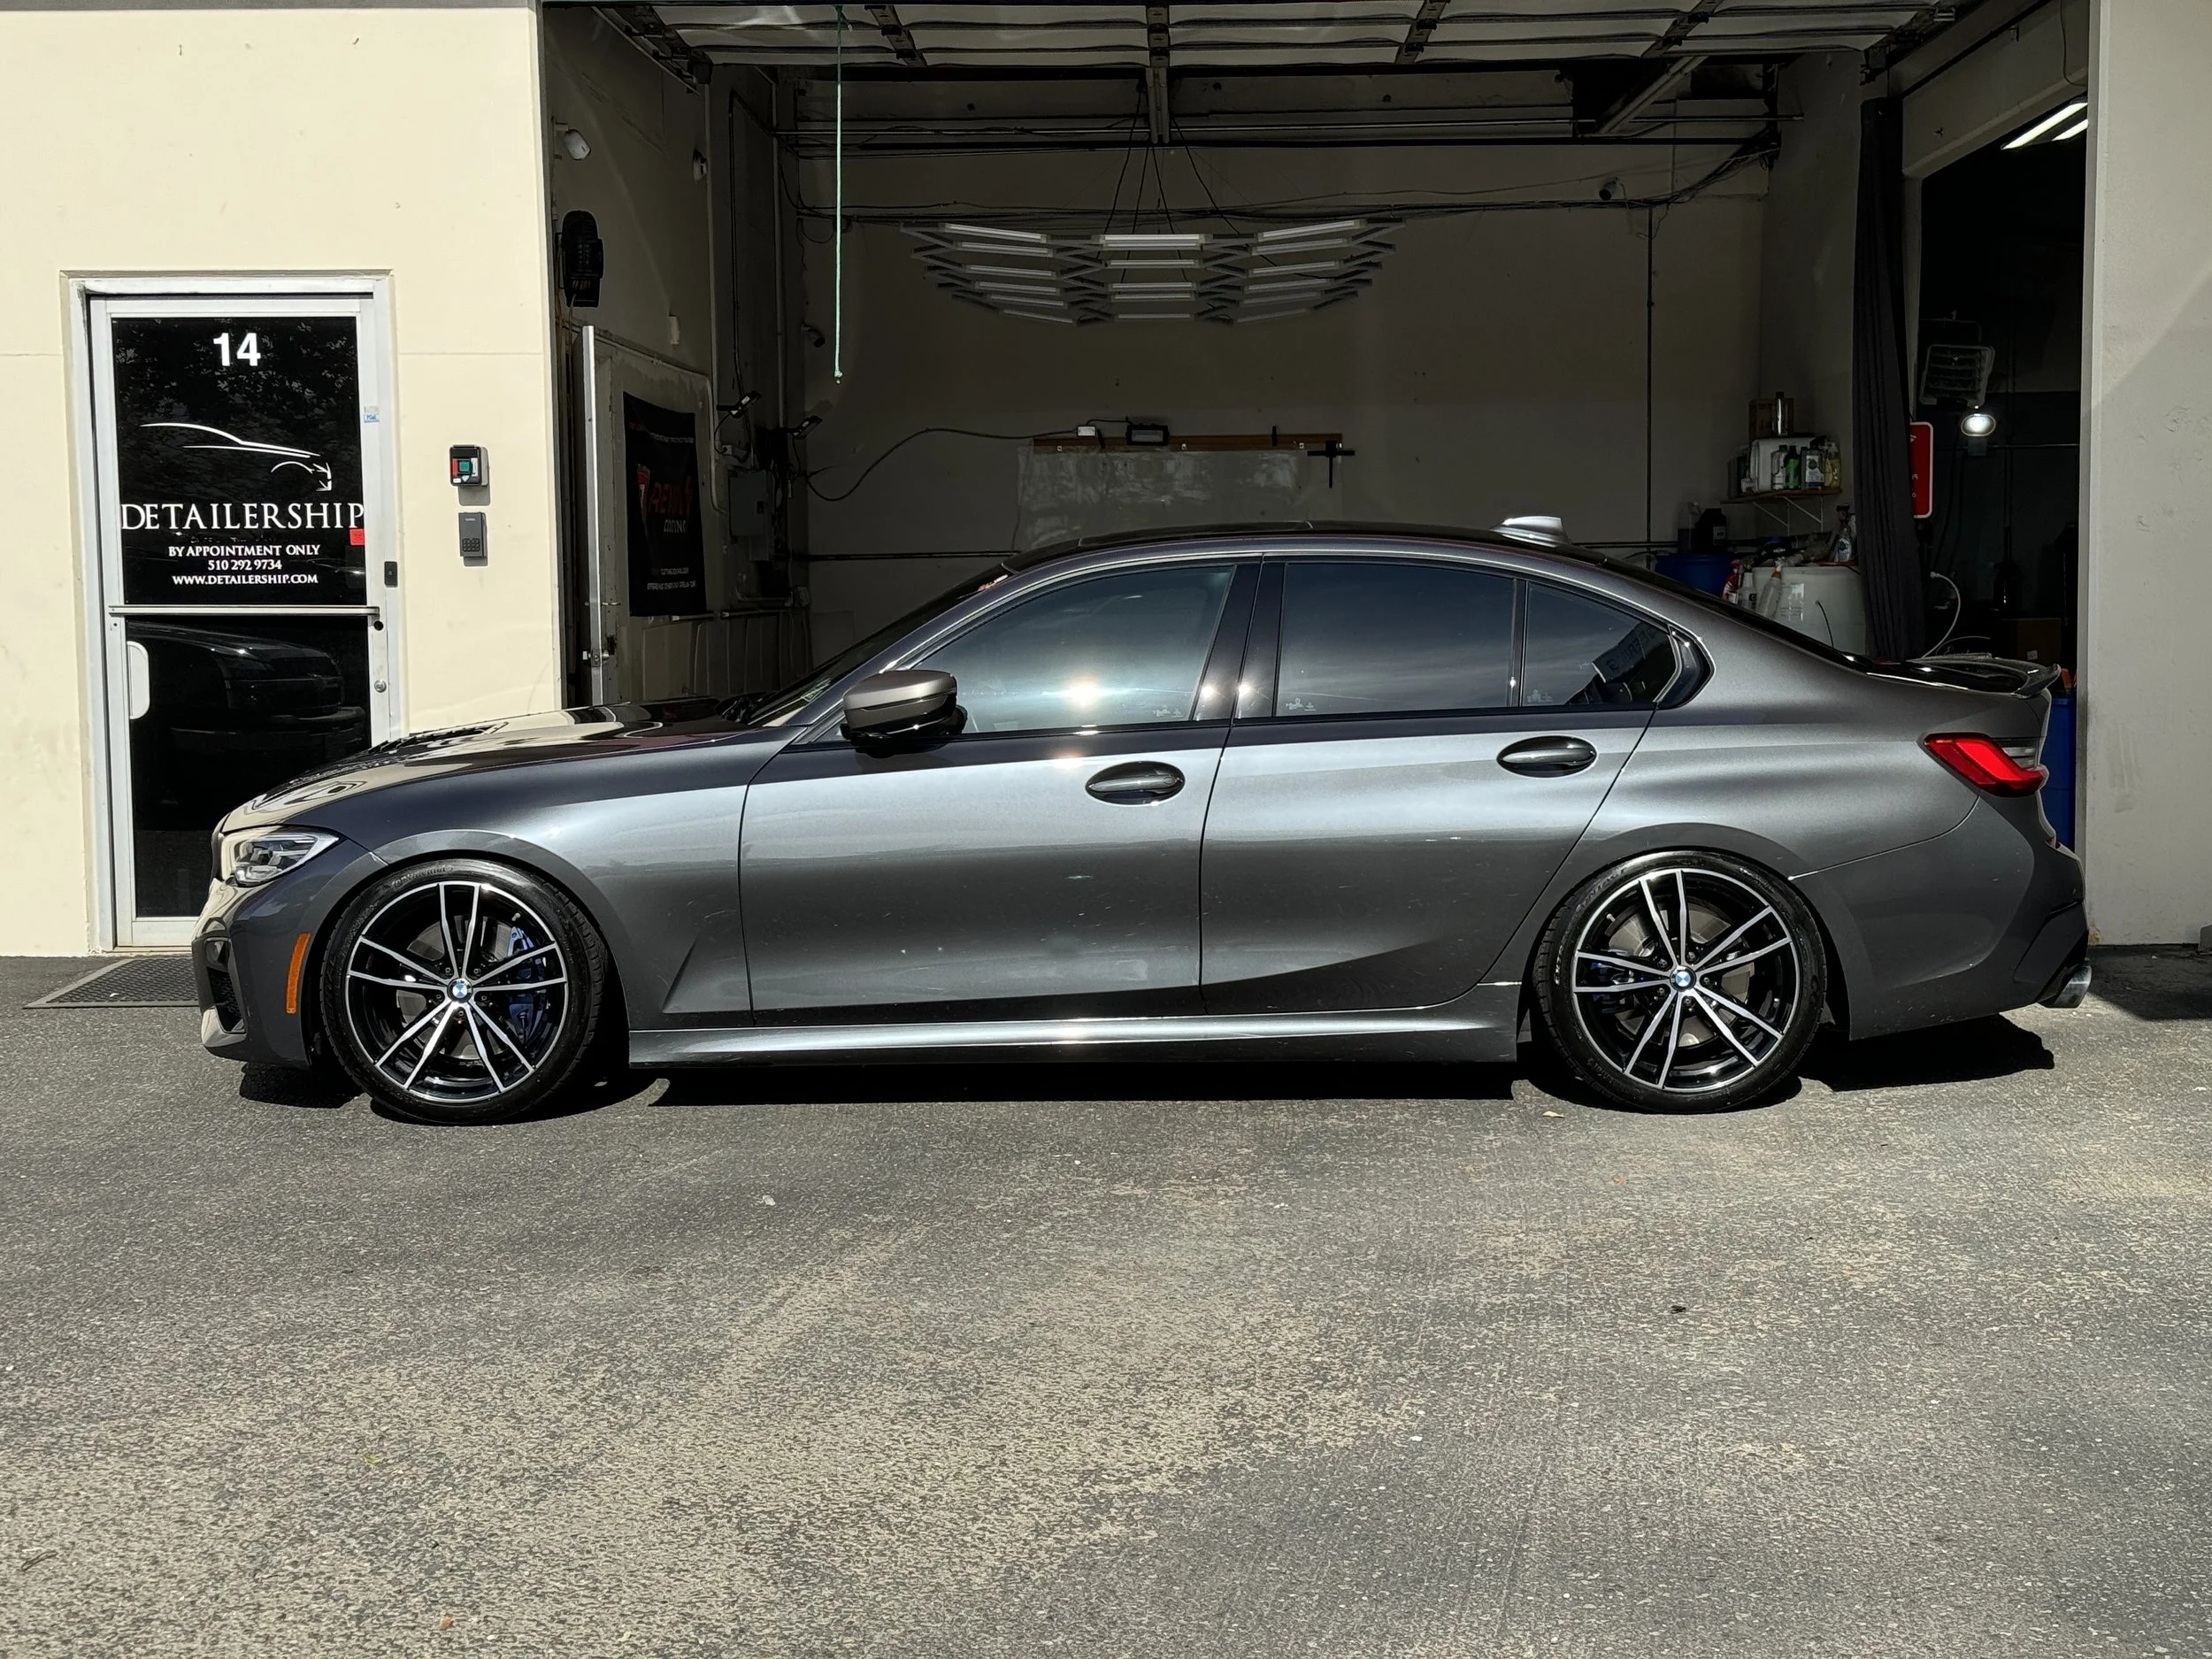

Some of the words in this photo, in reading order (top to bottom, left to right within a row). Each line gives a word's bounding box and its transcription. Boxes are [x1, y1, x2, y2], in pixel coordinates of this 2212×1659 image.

[212, 332, 261, 366] 14
[121, 503, 365, 531] DETAILERSHIP
[168, 545, 185, 557] BY
[186, 544, 282, 557] APPOINTMENT
[285, 544, 320, 556] ONLY
[207, 559, 229, 571] 510
[230, 559, 253, 571] 292
[254, 559, 282, 570] 9734
[172, 573, 319, 585] WWW.DETAILERSHIP.COM
